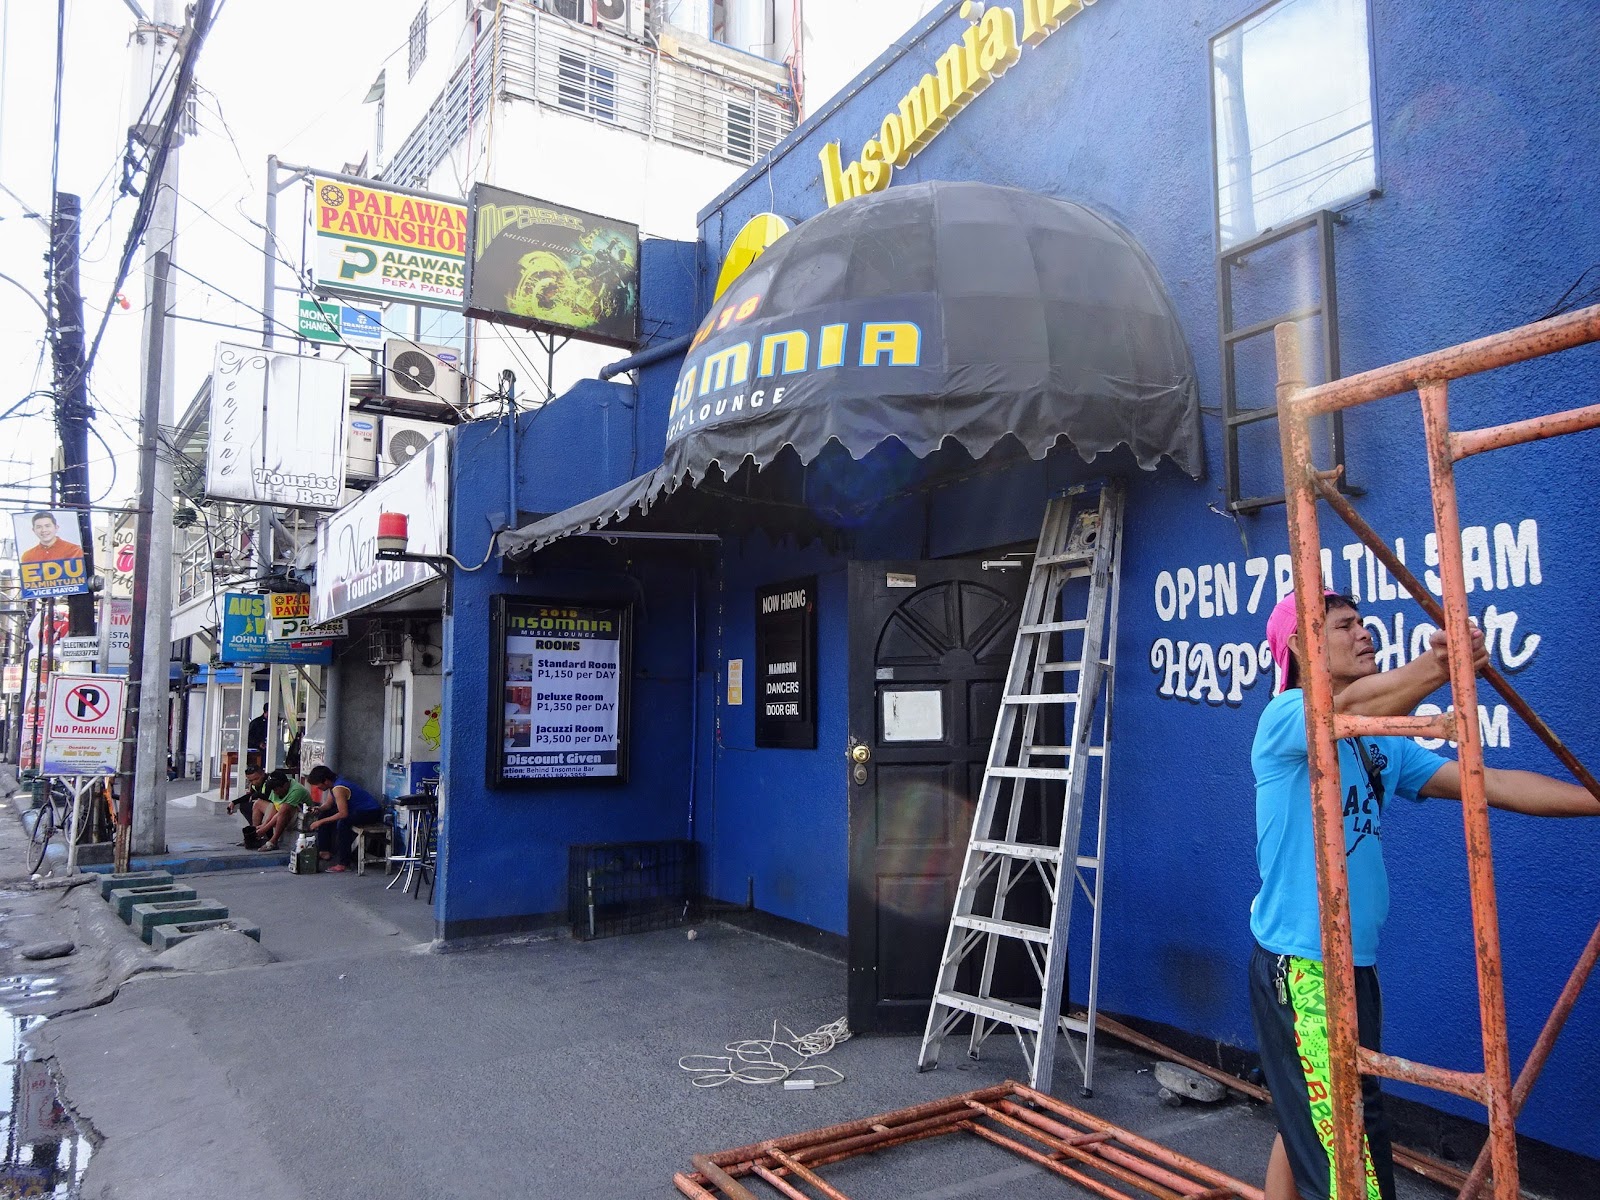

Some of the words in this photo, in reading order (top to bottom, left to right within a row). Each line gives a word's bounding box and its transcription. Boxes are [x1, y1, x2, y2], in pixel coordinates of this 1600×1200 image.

[819, 0, 1022, 208] Insomnia
[347, 188, 467, 231] PALAWAN
[503, 233, 540, 245] MUSIC
[382, 265, 465, 289] EXPRESS
[382, 278, 416, 290] PERA
[420, 284, 465, 298] PADALA
[300, 309, 338, 323] MONEY
[688, 387, 786, 426] LOUNGE
[254, 468, 337, 490] Tourist
[296, 488, 337, 506] Bar
[20, 559, 84, 583] EDU
[23, 577, 86, 590] PAMINTUAN
[346, 567, 383, 602] Tourist
[385, 560, 405, 586] Bar
[1154, 561, 1238, 622] OPEN
[1245, 557, 1269, 614] 7
[1342, 537, 1412, 604] TILL
[32, 589, 52, 597] VICE
[53, 586, 80, 595] MAYOR
[762, 594, 780, 614] NOW
[780, 589, 806, 611] HIRING
[540, 608, 578, 618] 2018
[64, 641, 98, 649] ELECTRICIAN
[231, 635, 257, 643] JOHN
[535, 639, 580, 651] ROOMS
[537, 659, 587, 669] Standard
[588, 660, 617, 670] Room
[768, 661, 797, 675] MAMASAN
[538, 669, 573, 680] P1,150
[576, 671, 593, 680] per
[595, 670, 616, 679] DAY
[767, 681, 800, 694] DANCERS
[536, 692, 573, 701] Deluxe
[575, 693, 604, 701] Room
[537, 702, 573, 713] P1,350
[575, 704, 592, 713] per
[594, 702, 615, 711] DAY
[766, 704, 784, 716] DOOR
[785, 703, 799, 715] GIRL
[54, 725, 69, 734] NO
[71, 725, 115, 735] PARKING
[536, 724, 573, 735] Jacuzzi
[575, 724, 604, 733] Room
[536, 734, 572, 744] P3,500
[574, 735, 592, 744] per
[594, 734, 614, 743] DAY
[506, 753, 565, 765] Discount
[566, 752, 602, 764] Given
